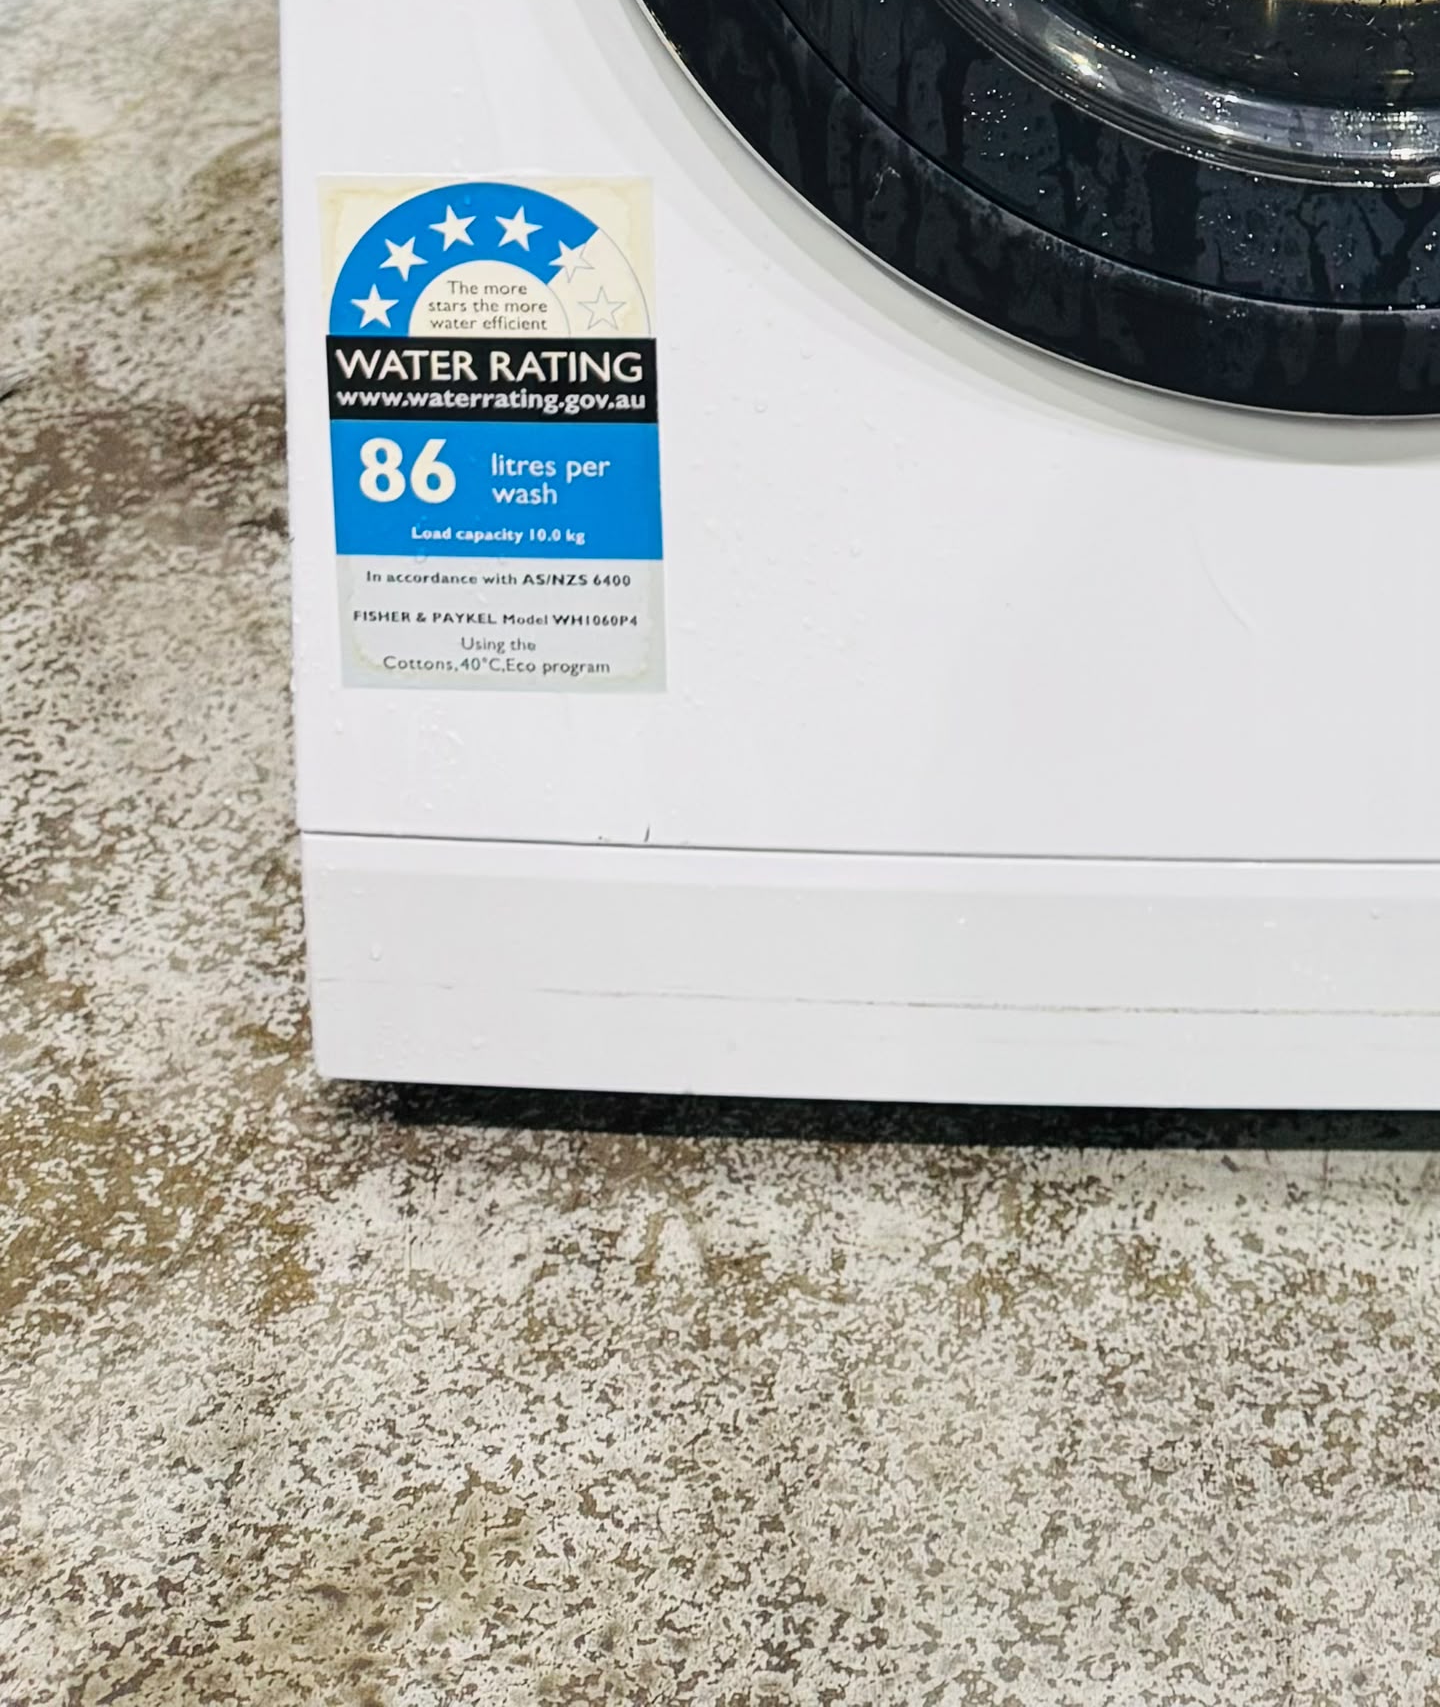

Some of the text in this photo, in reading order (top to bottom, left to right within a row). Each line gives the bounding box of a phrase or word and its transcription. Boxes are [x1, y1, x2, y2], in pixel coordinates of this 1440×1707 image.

[447, 280, 527, 295] The more
[428, 299, 548, 313] stars the more
[430, 316, 548, 330] water efficient
[335, 348, 643, 383] WATER RATING
[337, 388, 646, 414] www.waterrating.gov.au
[358, 437, 456, 503] 86
[491, 454, 610, 483] litres per
[493, 483, 558, 505] wash
[411, 527, 585, 545] Load capacity 10.0 kg
[366, 571, 631, 586] In accordance with AS/NZS 6400
[353, 611, 410, 623] FISHER
[416, 612, 426, 623] &
[432, 613, 497, 624] PAYKEL
[503, 614, 548, 625] Model
[461, 637, 536, 653] Using the
[542, 659, 610, 676] program
